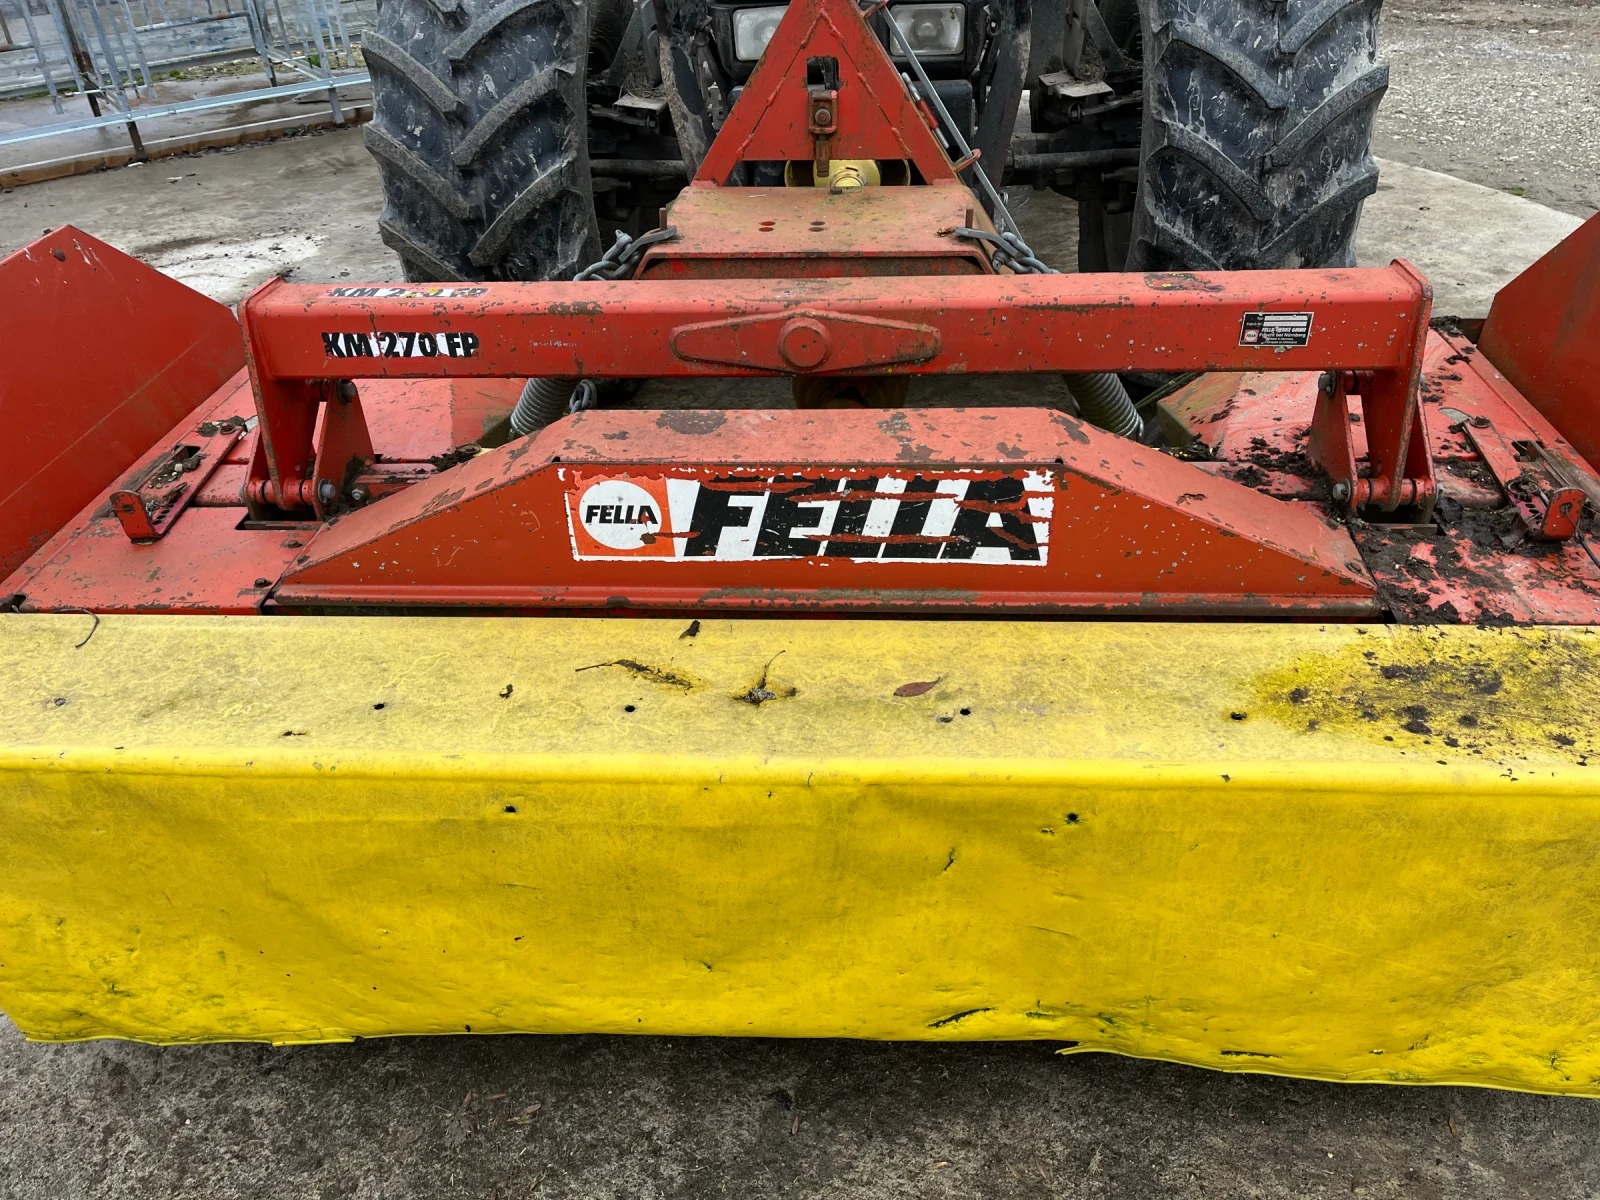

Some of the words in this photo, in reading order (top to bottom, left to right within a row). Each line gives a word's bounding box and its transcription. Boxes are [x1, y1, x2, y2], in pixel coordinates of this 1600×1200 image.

[328, 287, 380, 297] KM
[322, 332, 374, 358] KM
[379, 332, 439, 358] 270
[445, 332, 480, 358] FP
[585, 504, 659, 525] FELLA
[684, 475, 1041, 561] FELLA
